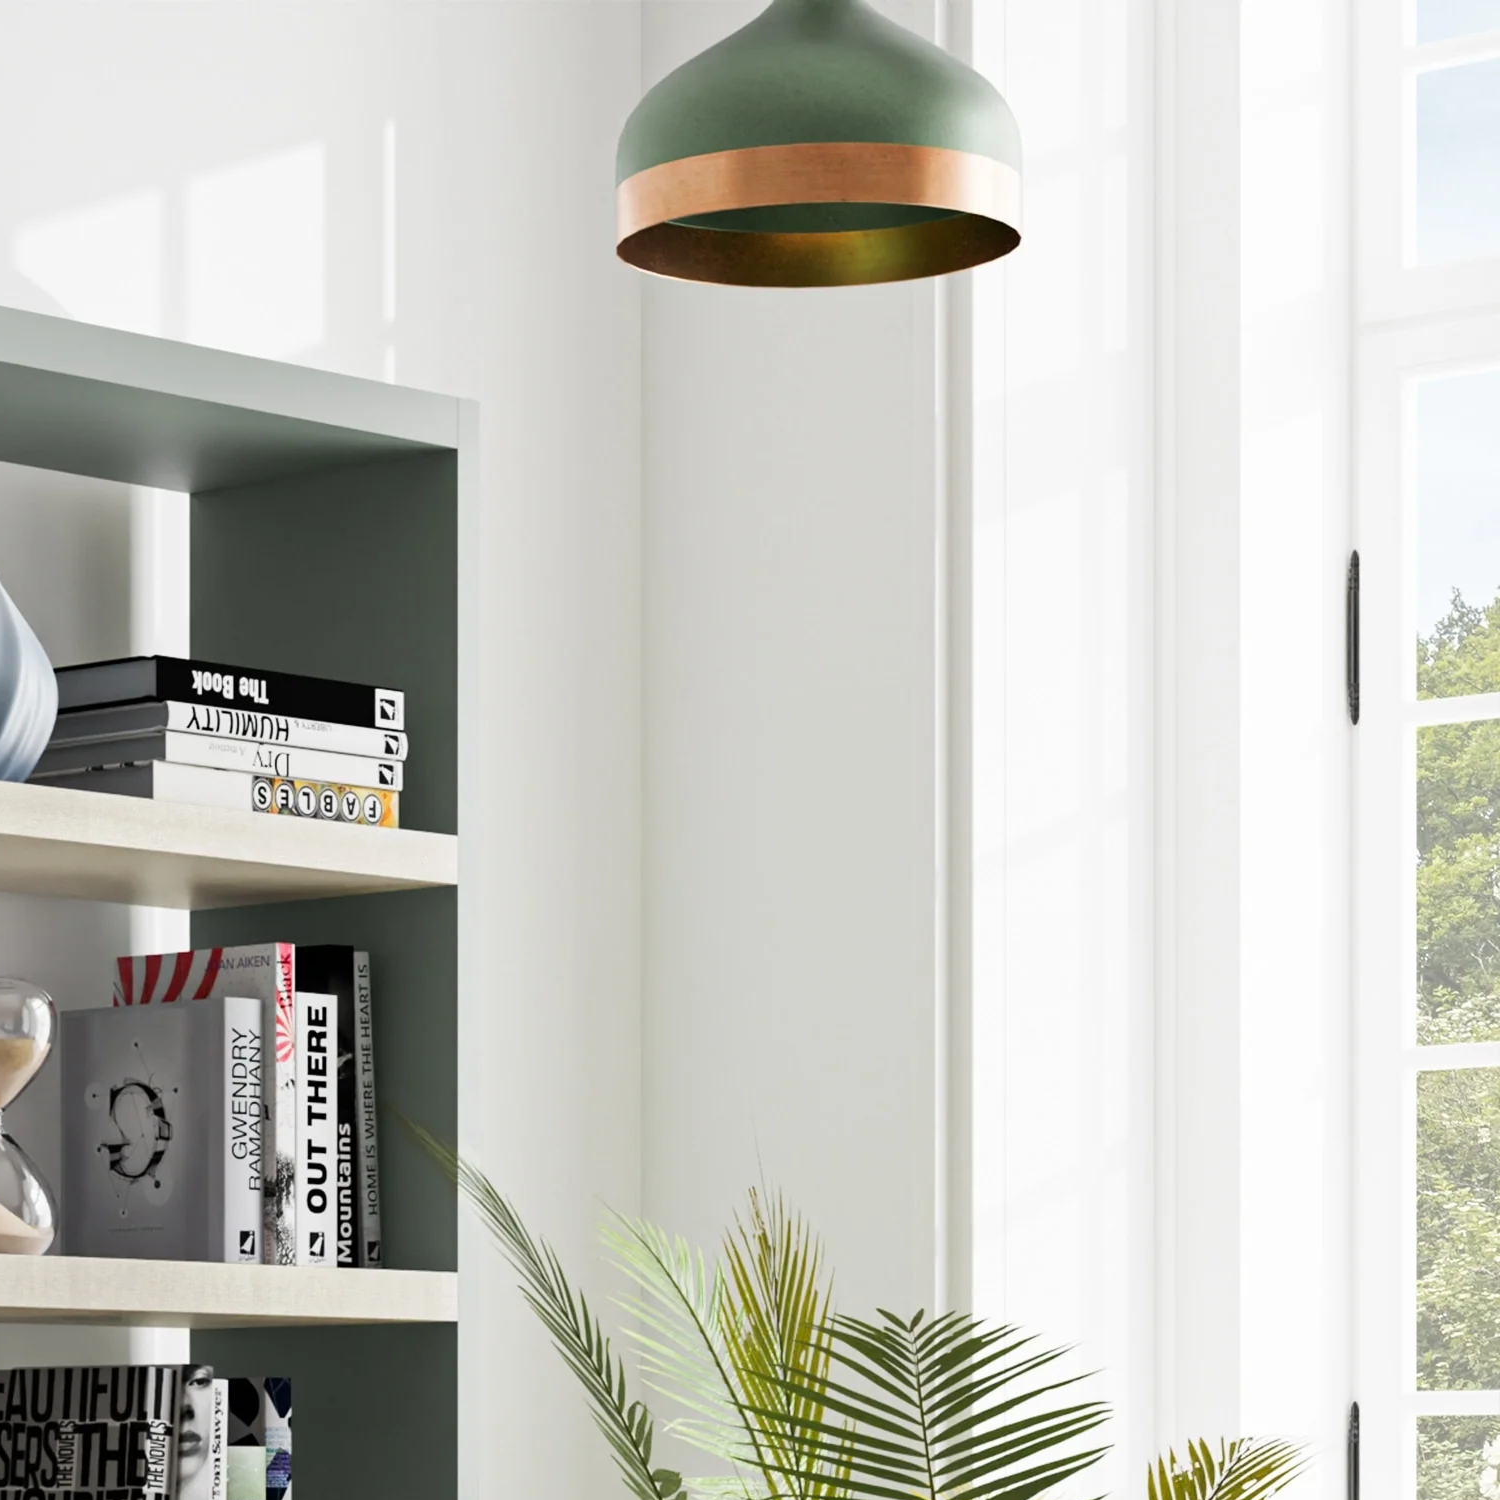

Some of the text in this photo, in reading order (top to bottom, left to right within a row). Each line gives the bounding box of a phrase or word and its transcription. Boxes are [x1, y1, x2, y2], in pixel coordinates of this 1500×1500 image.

[191, 669, 269, 704] The Book
[187, 706, 289, 742] HUMILITY
[252, 742, 291, 777] Dry
[255, 784, 379, 820] FABLES
[237, 956, 270, 968] AIKEN
[231, 1028, 248, 1159] GWENDRY
[358, 964, 378, 1216] HOME IS WHERE THE HEART IS
[248, 1029, 261, 1191] RAMADHANY
[307, 1006, 327, 1214] OUT THERE
[336, 1122, 353, 1263] Mountains
[211, 1388, 223, 1454] Sawyer
[56, 1466, 74, 1488] THE
[147, 1467, 164, 1490] THE
[211, 1458, 221, 1499] Tom
